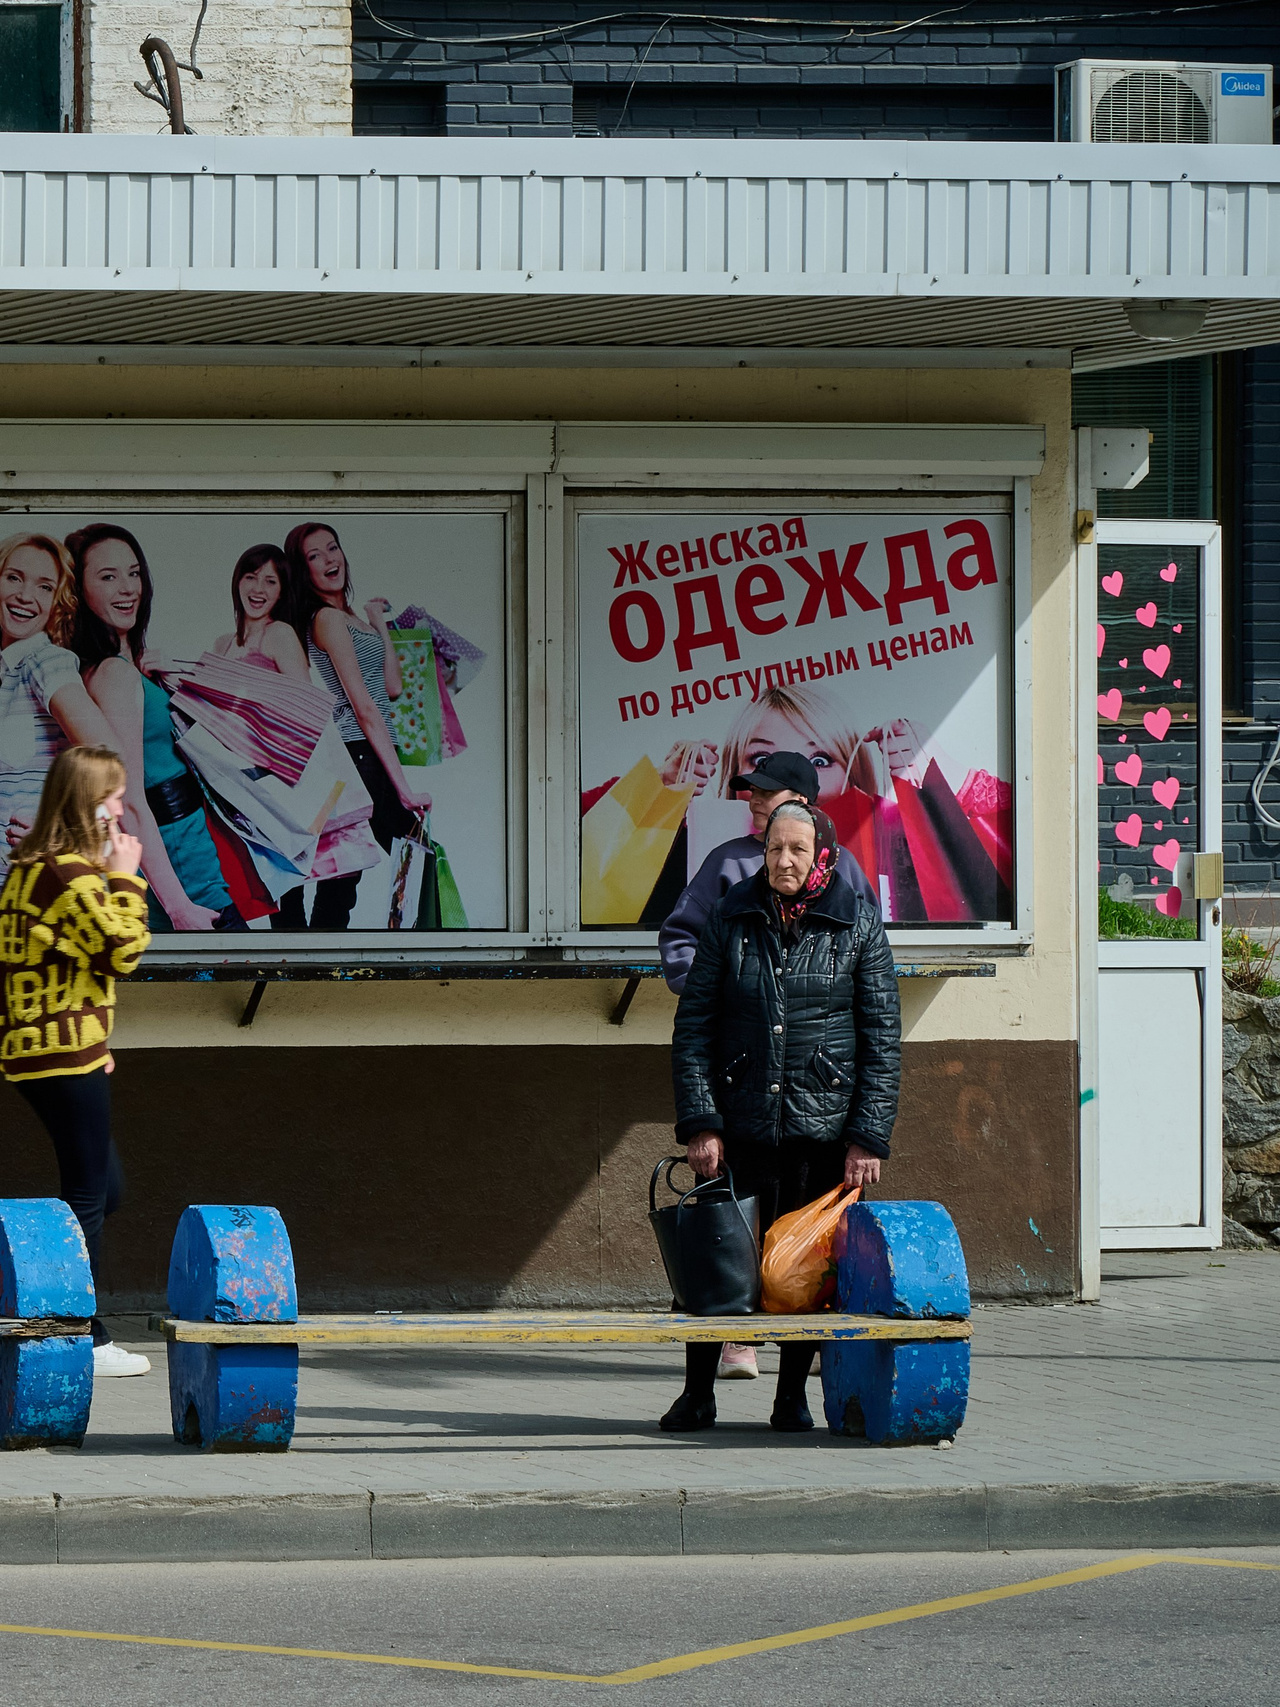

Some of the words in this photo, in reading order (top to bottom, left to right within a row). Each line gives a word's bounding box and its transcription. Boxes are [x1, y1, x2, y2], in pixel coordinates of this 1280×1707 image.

[1225, 77, 1261, 92] Midea
[607, 517, 809, 588] Женская
[608, 519, 999, 673] одежда
[618, 691, 660, 722] по
[671, 646, 860, 718] доступным
[867, 621, 975, 671] ценам
